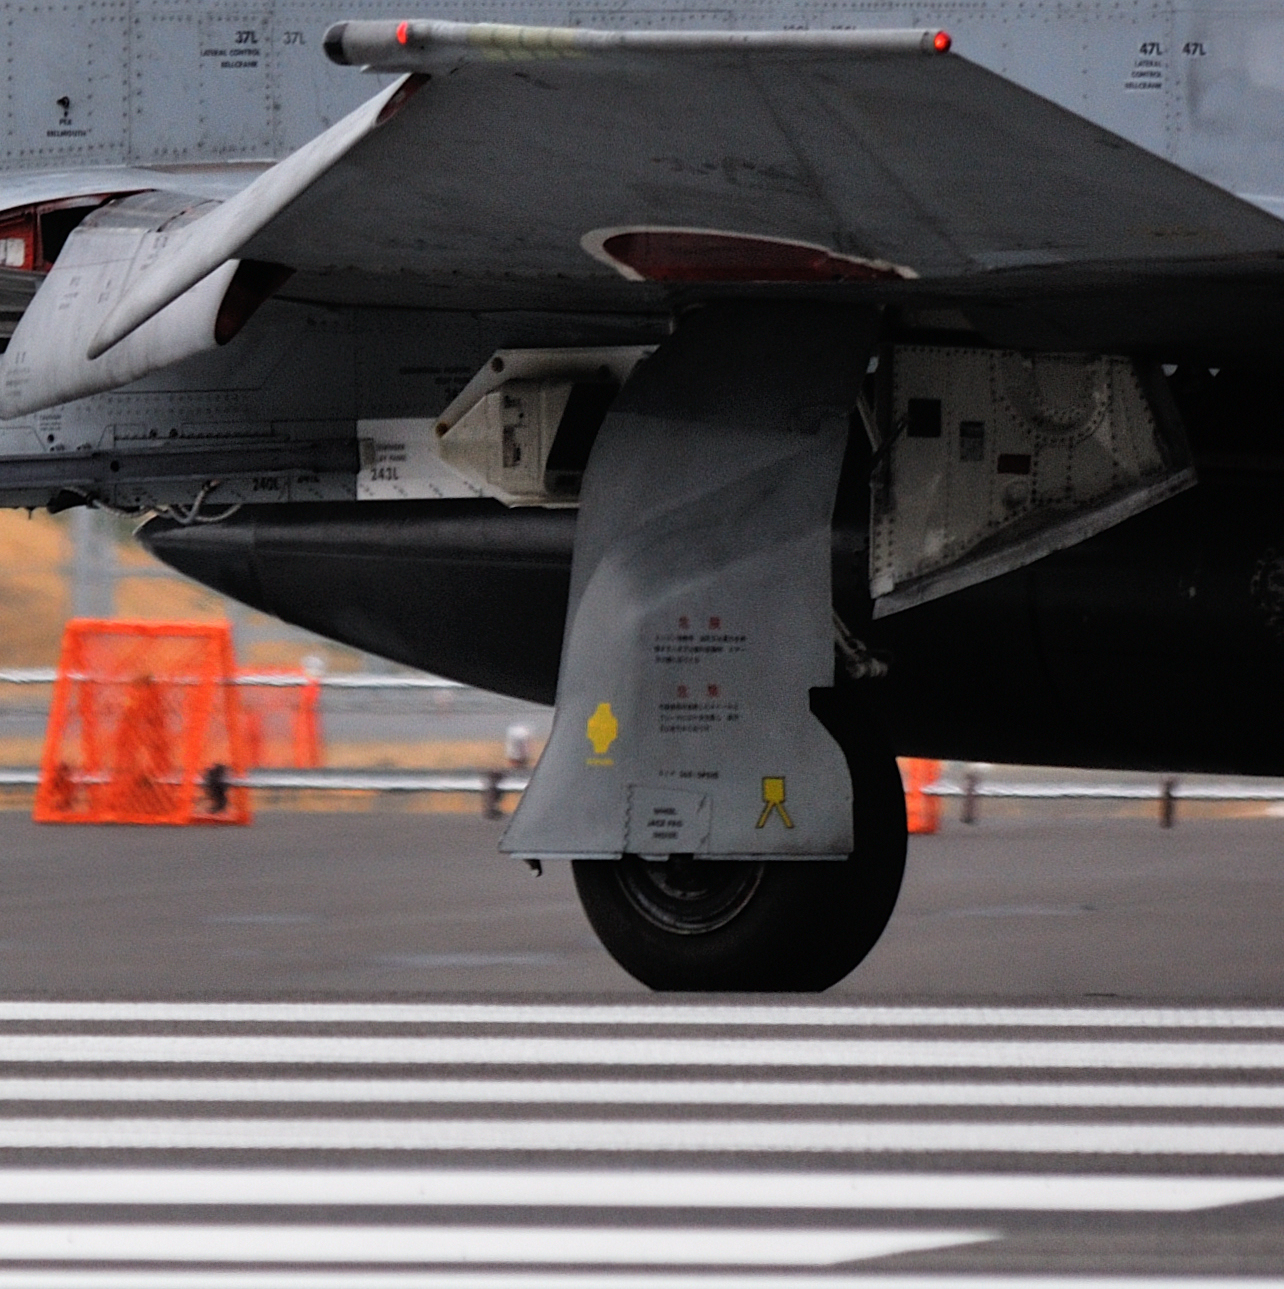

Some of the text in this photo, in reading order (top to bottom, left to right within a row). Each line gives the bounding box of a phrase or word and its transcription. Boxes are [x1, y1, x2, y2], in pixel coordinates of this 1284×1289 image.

[234, 30, 259, 44] 37L
[282, 31, 307, 45] 37L
[1139, 42, 1163, 56] 47L
[1181, 42, 1207, 56] 47L
